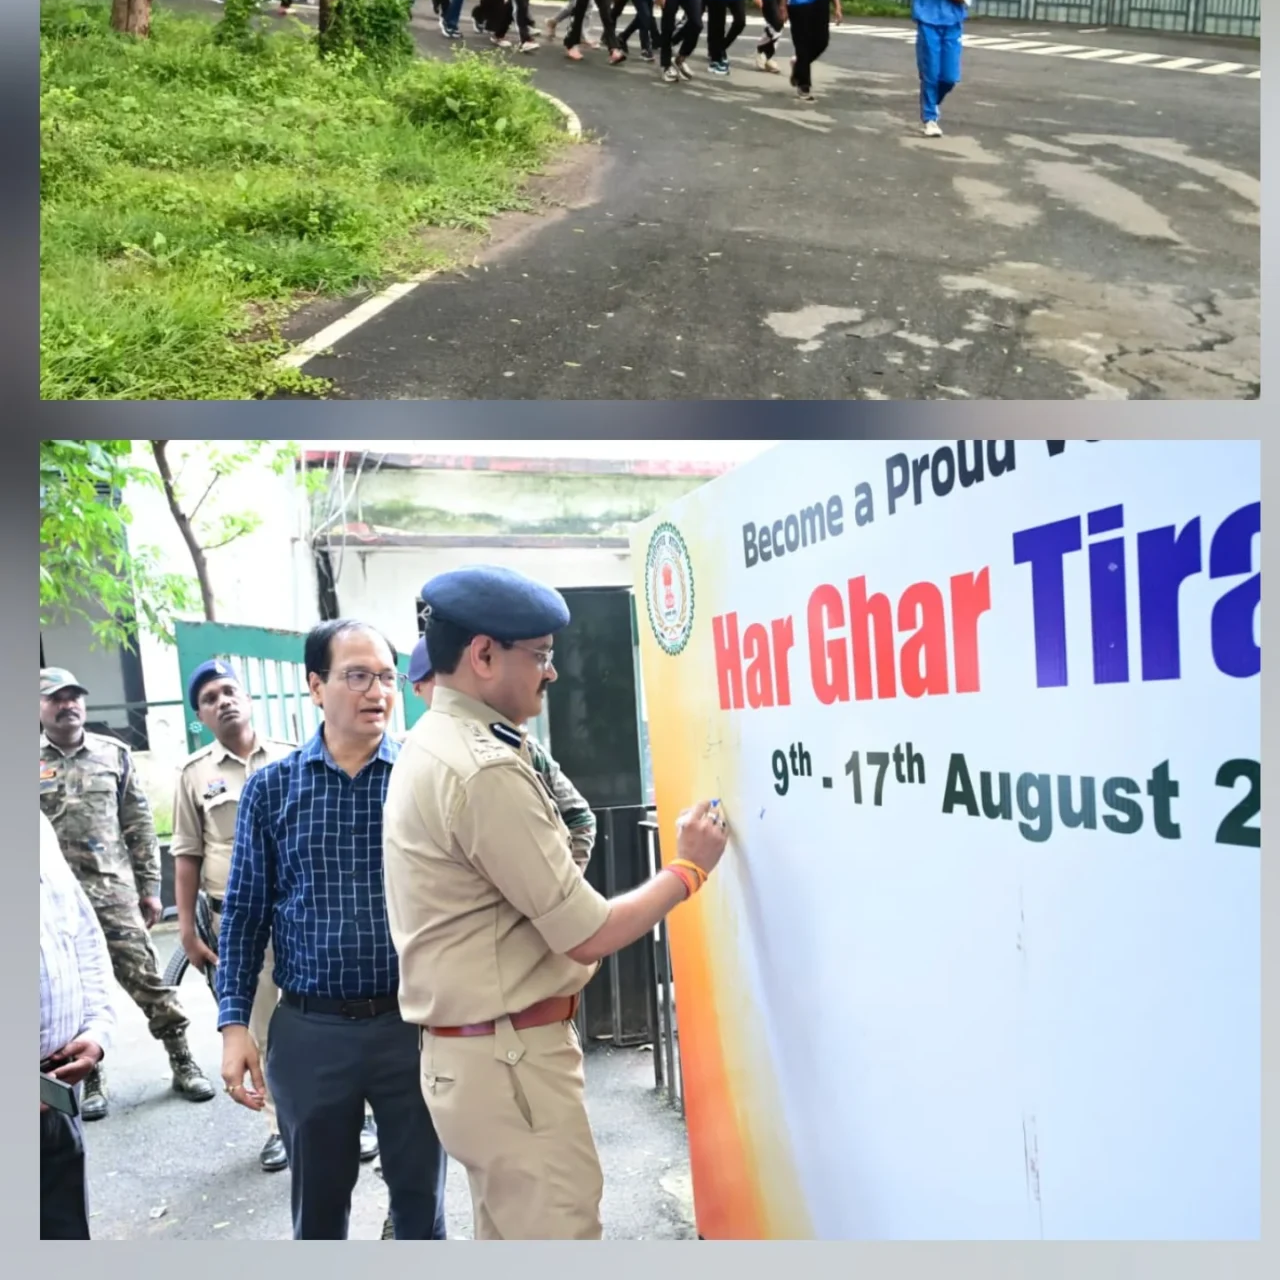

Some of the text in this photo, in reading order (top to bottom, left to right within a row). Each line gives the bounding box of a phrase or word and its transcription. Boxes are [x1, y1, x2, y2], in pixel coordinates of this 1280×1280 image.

[742, 496, 844, 569] Become
[854, 481, 874, 527] a
[885, 440, 1016, 515] Proud
[711, 611, 794, 711] Har
[807, 565, 991, 706] Ghar
[771, 742, 812, 796] 9th
[845, 742, 926, 807] 17th
[941, 752, 1182, 843] August
